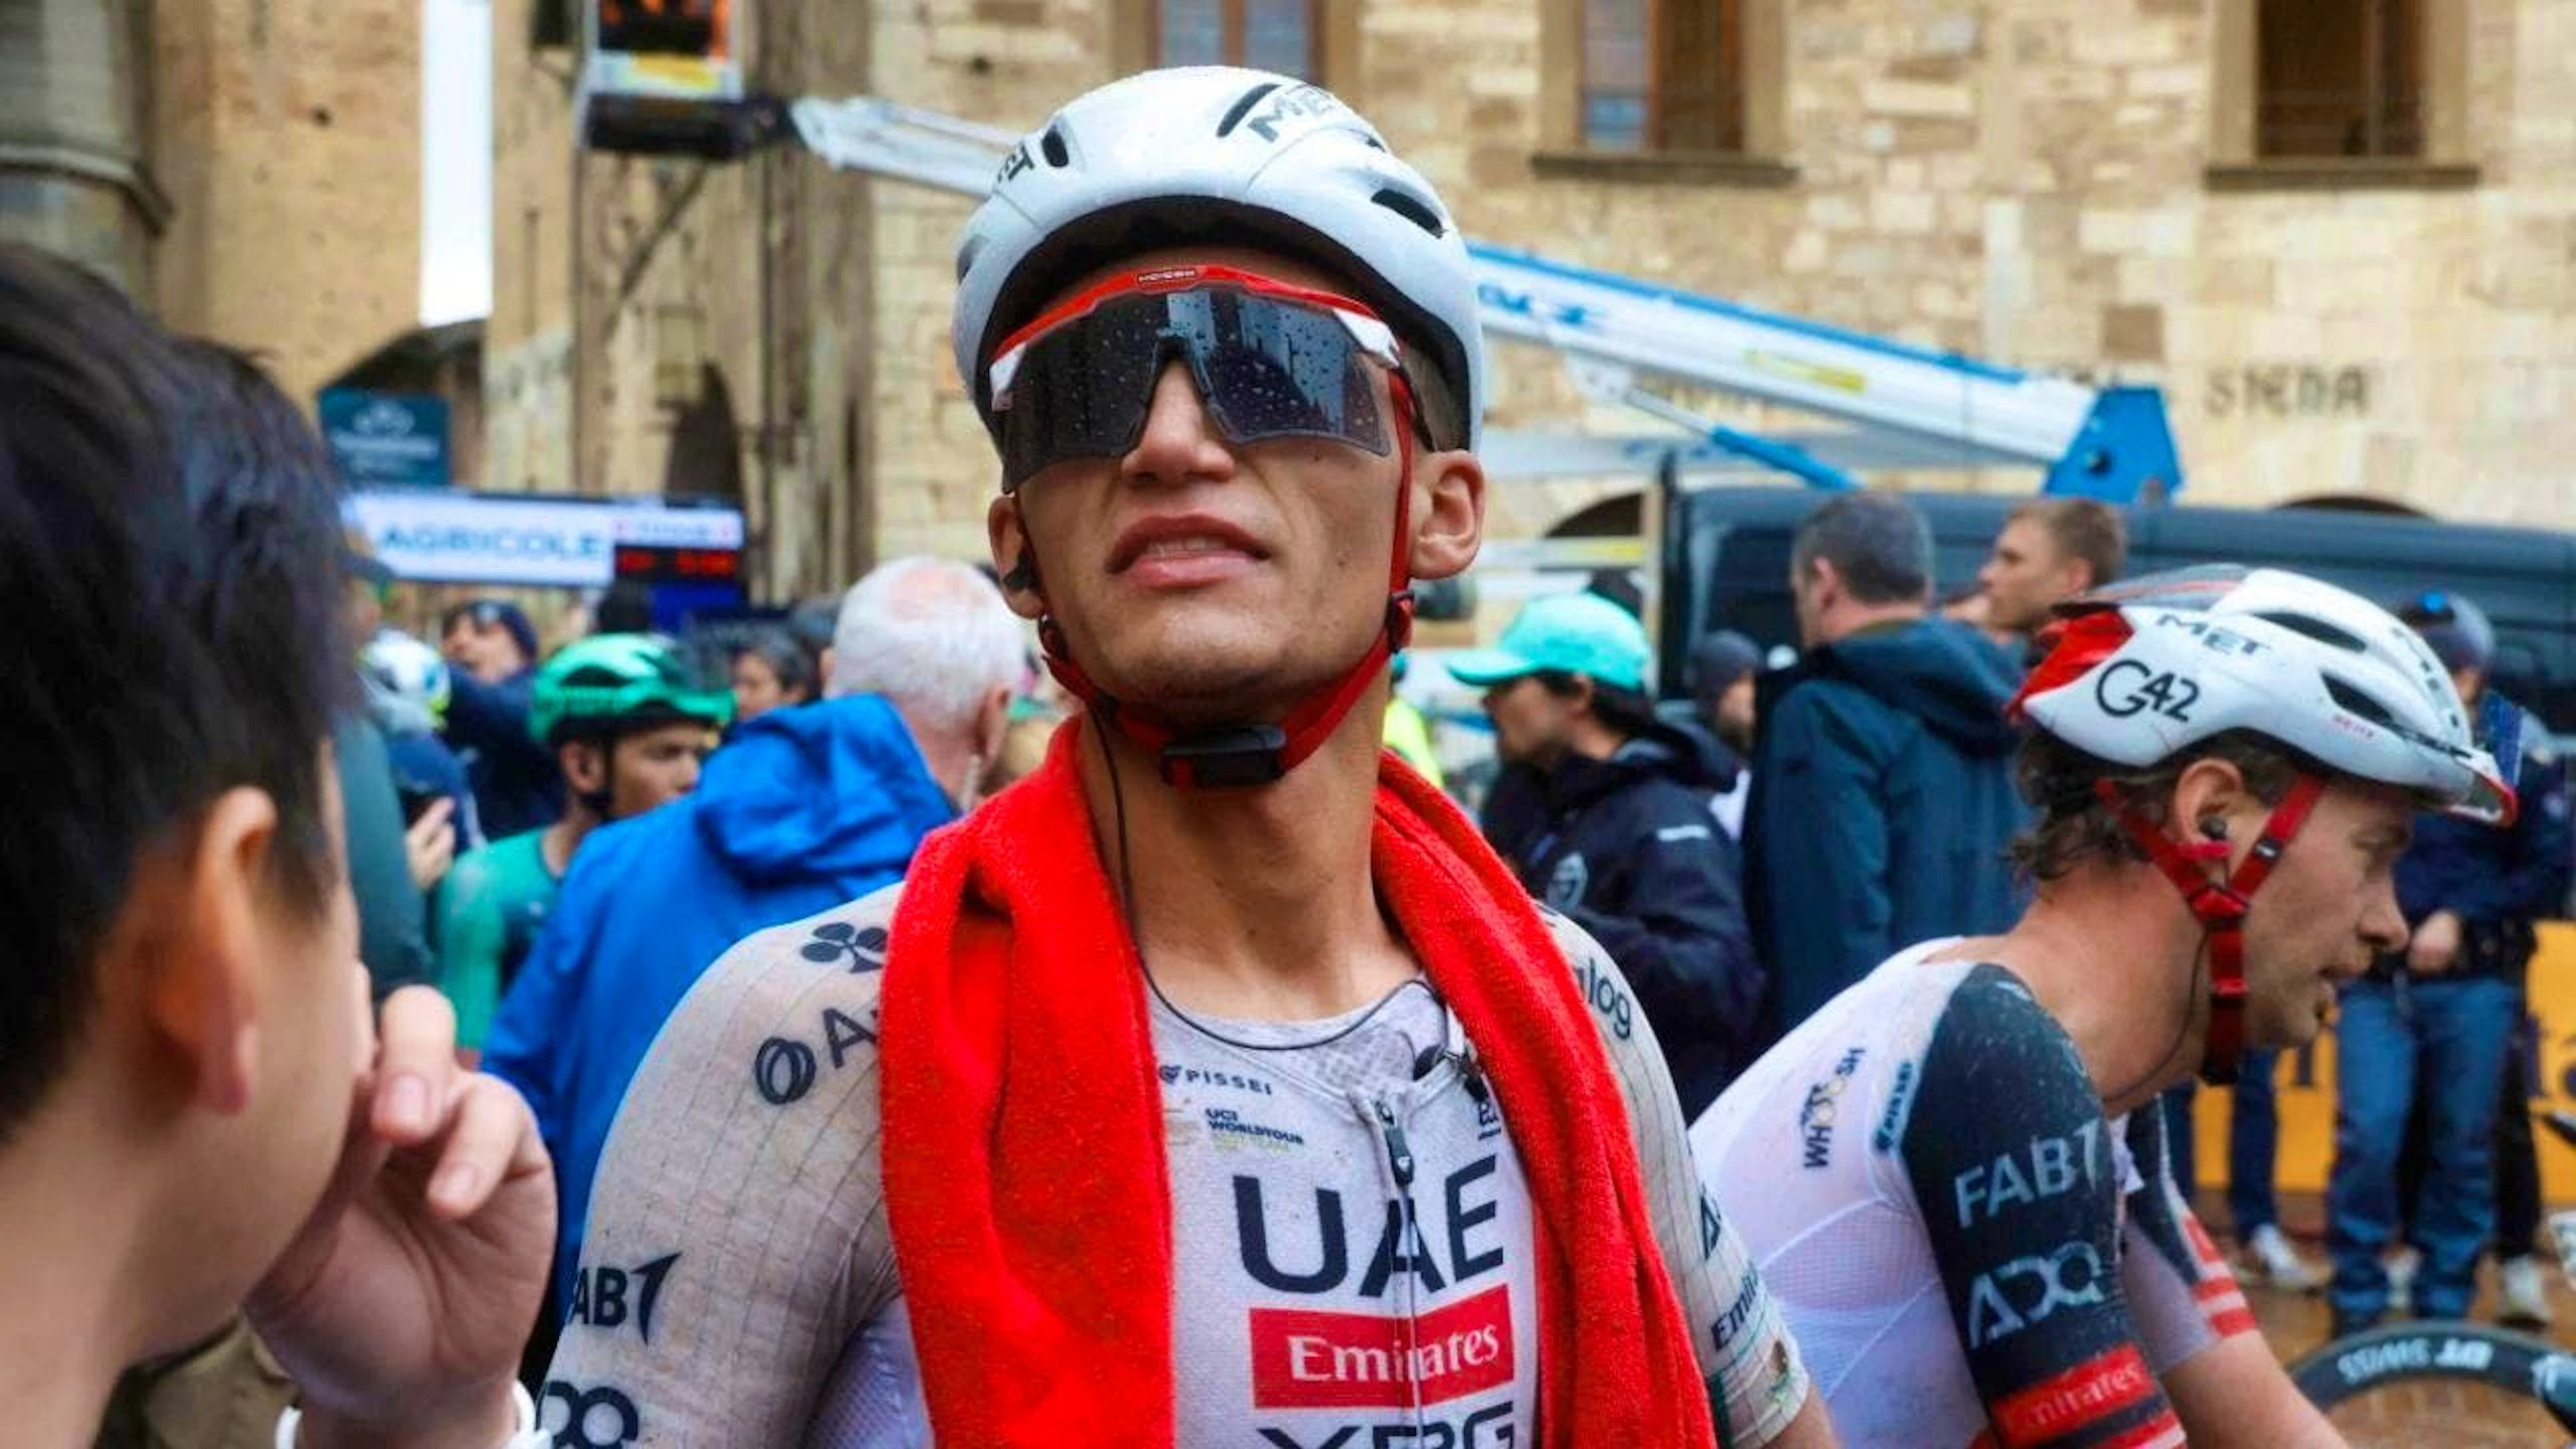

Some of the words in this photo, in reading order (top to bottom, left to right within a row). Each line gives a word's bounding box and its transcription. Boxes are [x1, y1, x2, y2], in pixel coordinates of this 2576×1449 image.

[384, 526, 602, 557] AGRICOLE
[2153, 613, 2271, 657] MET
[2095, 659, 2201, 723] G42
[1185, 1069, 1273, 1095] PISSEI
[1205, 1108, 1238, 1122] UCI
[1208, 1120, 1305, 1145] WORLDTOUR
[1232, 1154, 1504, 1297] UAE
[1287, 1324, 1499, 1382] Emirates
[2336, 1338, 2431, 1385] SWISS
